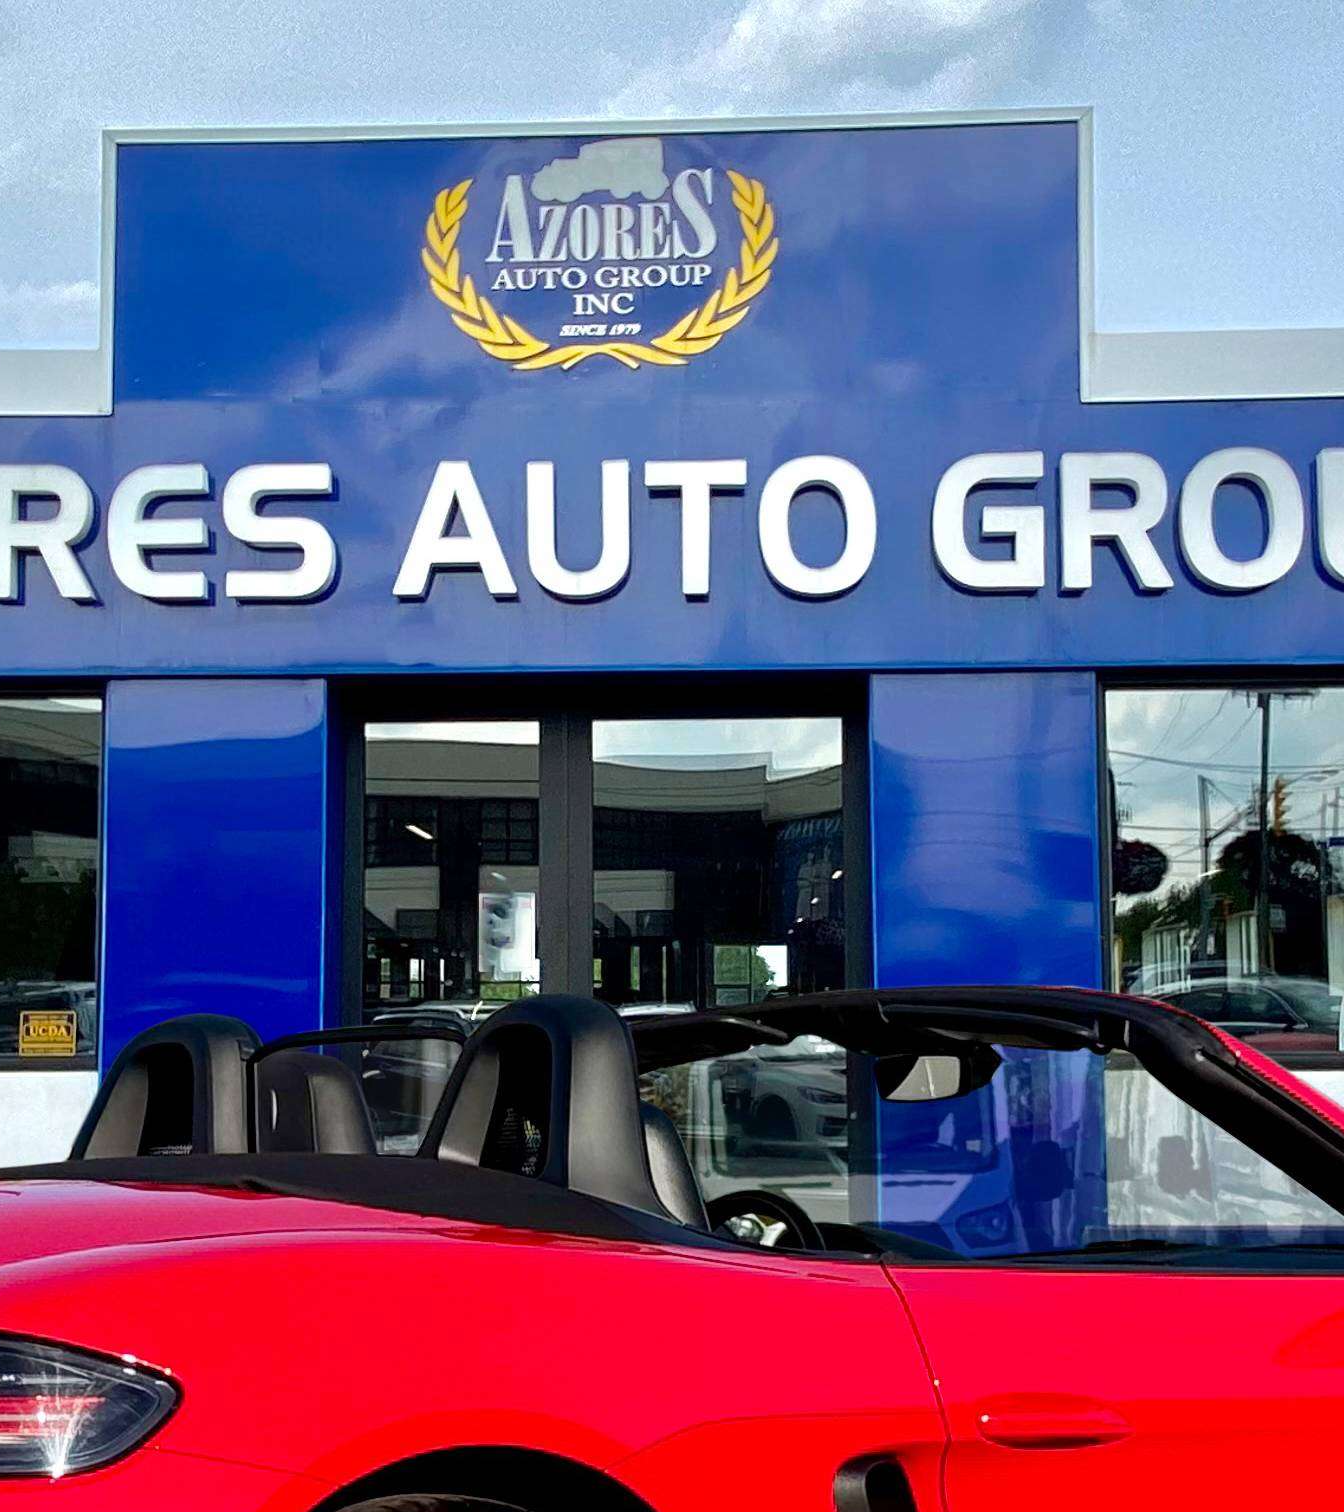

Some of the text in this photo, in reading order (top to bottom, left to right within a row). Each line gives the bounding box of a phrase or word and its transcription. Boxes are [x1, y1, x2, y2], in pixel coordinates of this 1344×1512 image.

[485, 168, 717, 263] AZORES
[491, 264, 711, 290] AUTO GROUP
[573, 293, 635, 316] INC
[559, 323, 642, 337] SINCE 1979
[393, 455, 876, 598] AUTO
[29, 1025, 68, 1037] UCDA
